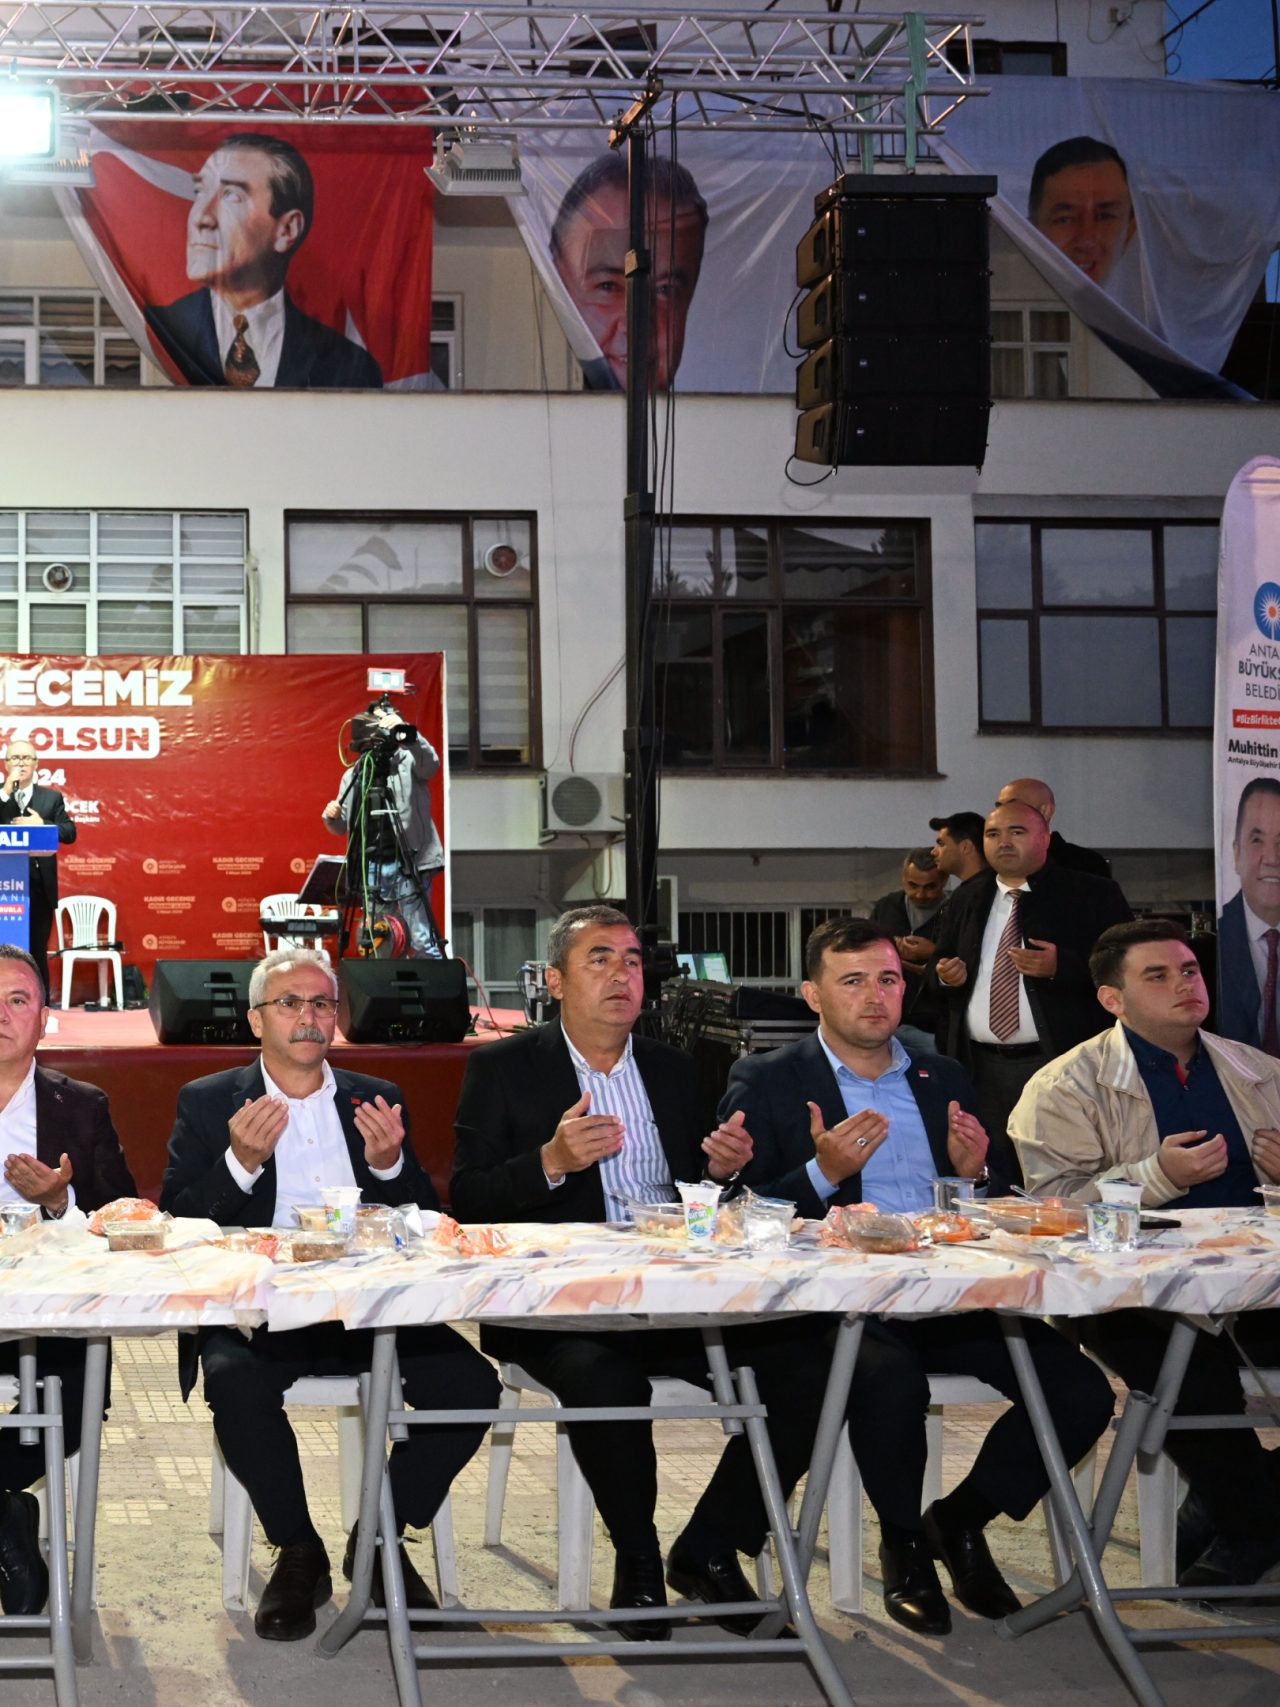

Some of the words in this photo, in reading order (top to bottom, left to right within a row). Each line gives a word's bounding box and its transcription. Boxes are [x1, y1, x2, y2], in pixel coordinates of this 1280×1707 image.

[1238, 658, 1280, 681] BÜYÜK
[28, 727, 150, 752] OLSUN
[1228, 739, 1278, 758] Muhittin
